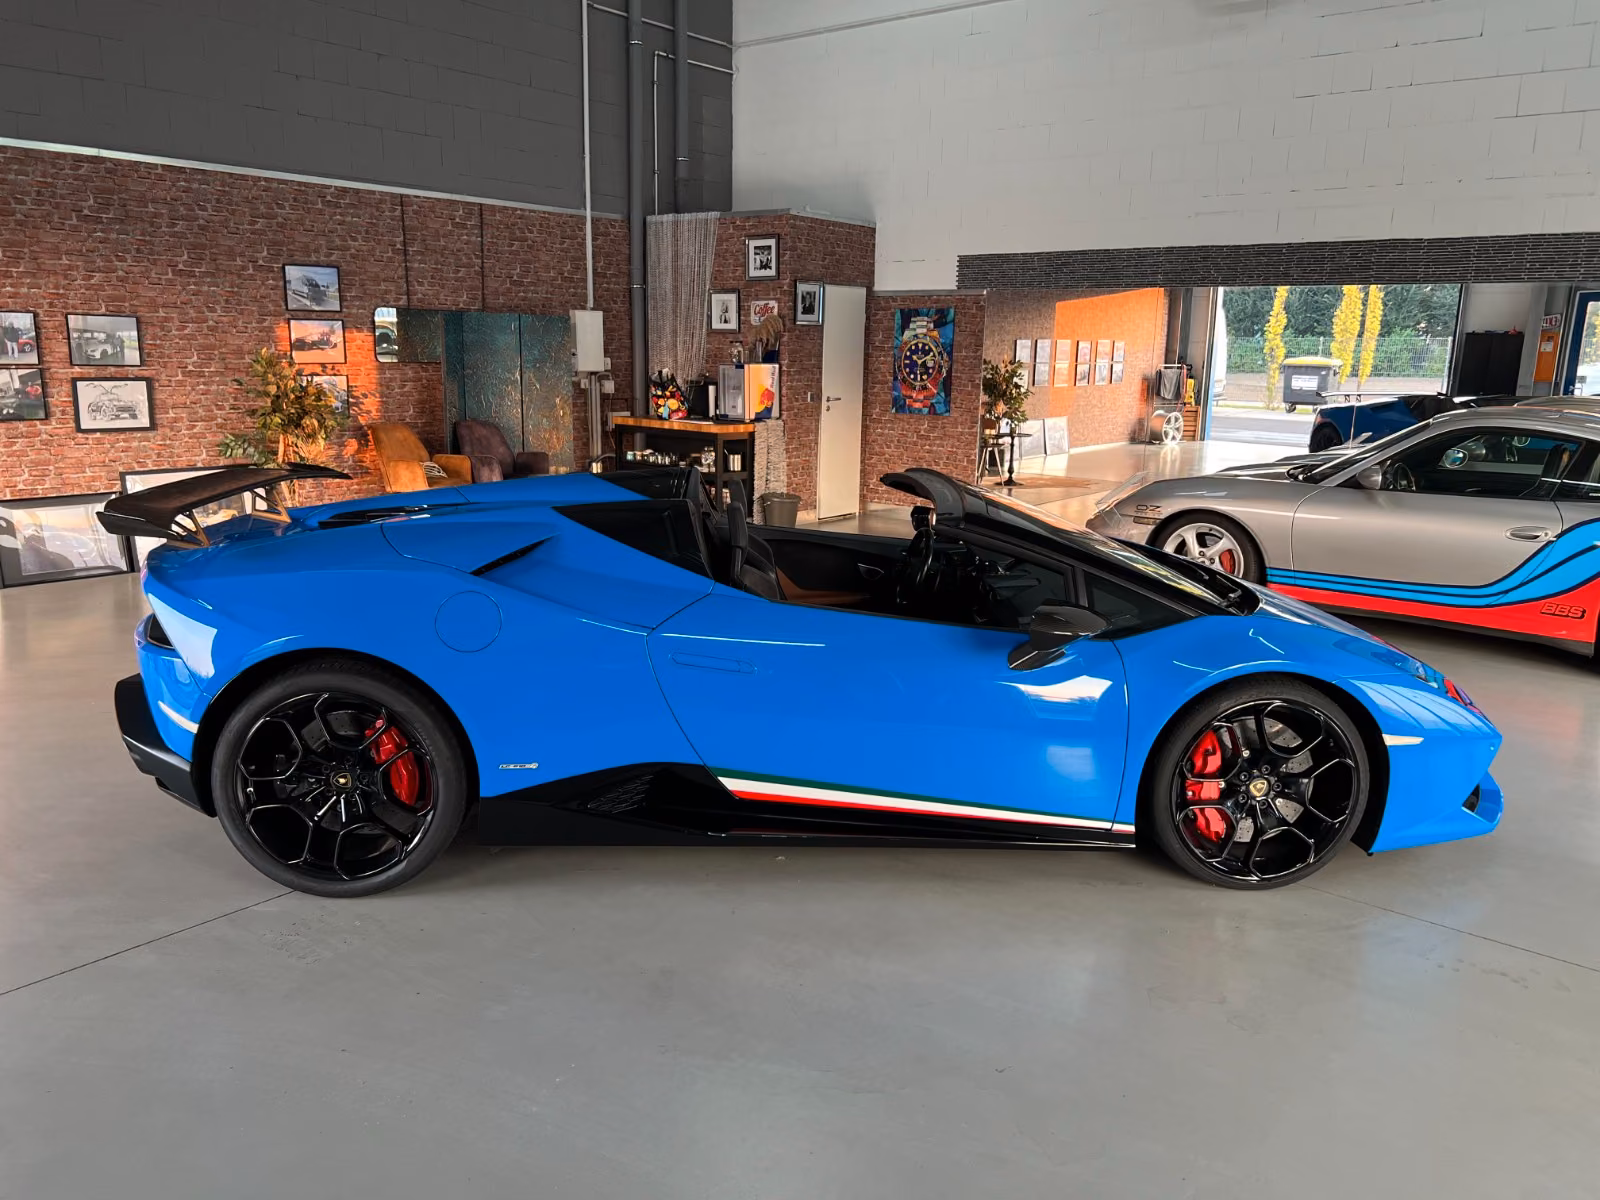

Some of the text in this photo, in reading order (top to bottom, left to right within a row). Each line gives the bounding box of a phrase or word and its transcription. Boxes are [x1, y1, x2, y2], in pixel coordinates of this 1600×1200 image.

[753, 302, 775, 317] Coffee
[1136, 504, 1162, 513] OZ
[1540, 602, 1586, 620] BBS
